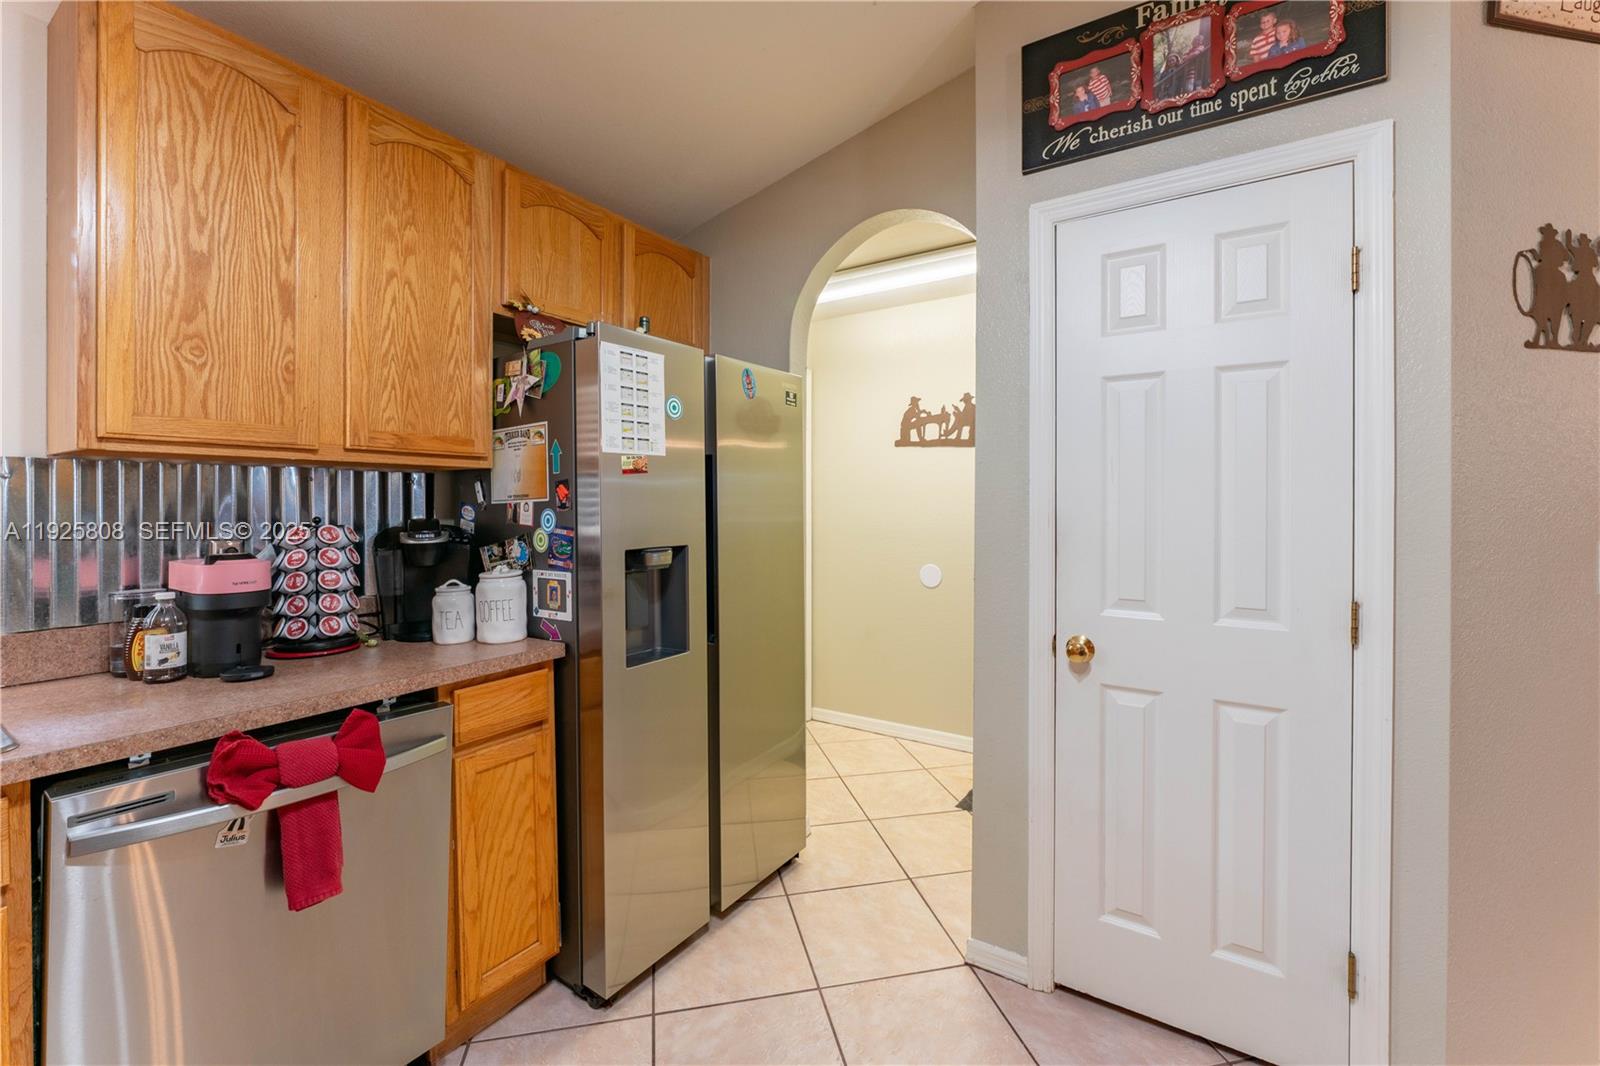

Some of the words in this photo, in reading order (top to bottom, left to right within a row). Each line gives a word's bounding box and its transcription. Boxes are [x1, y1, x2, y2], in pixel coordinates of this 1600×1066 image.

[1042, 127, 1093, 160] We
[1089, 117, 1153, 145] cherish
[1157, 109, 1183, 127] our
[1190, 99, 1222, 118] time
[1230, 76, 1278, 108] spent
[1283, 53, 1360, 100] together
[439, 610, 464, 631] TEA
[479, 599, 514, 623] COFFEE
